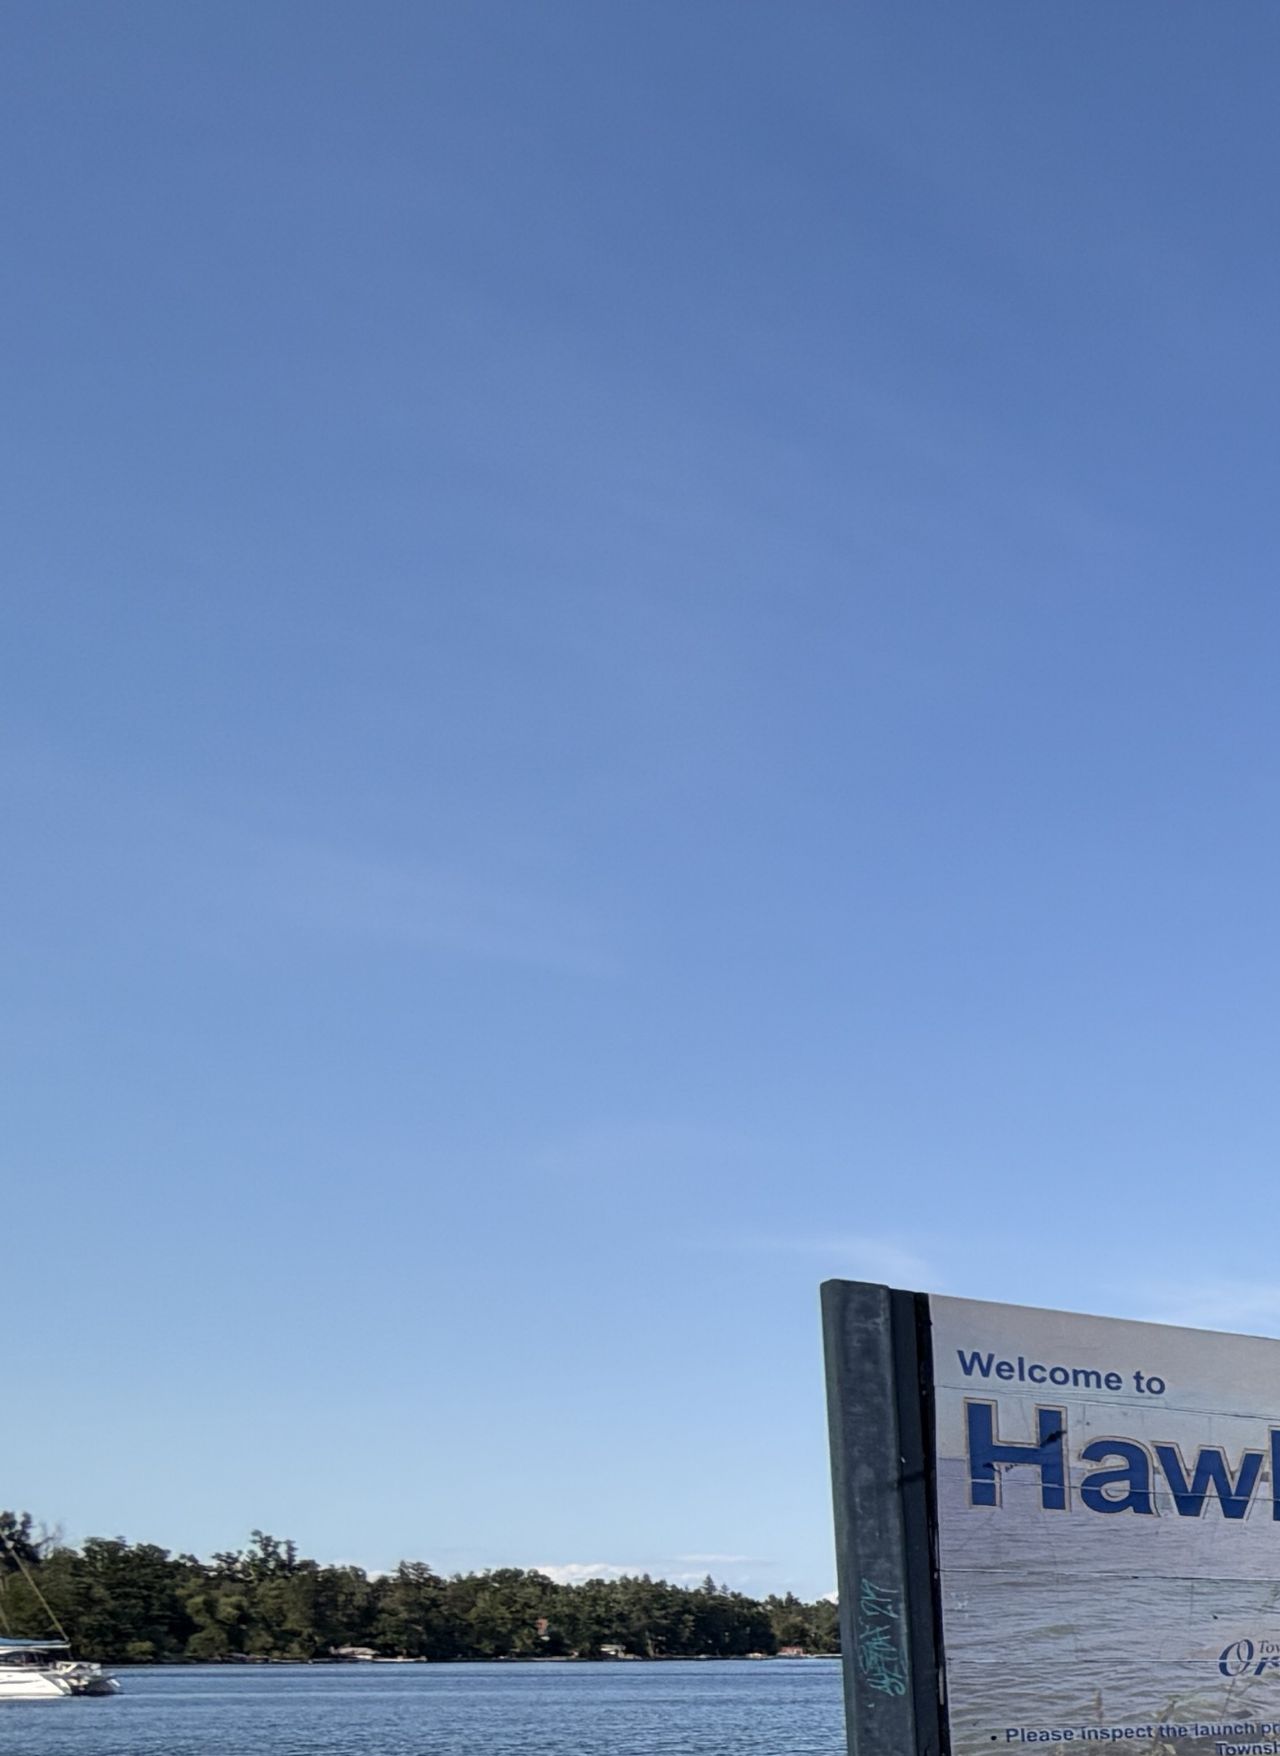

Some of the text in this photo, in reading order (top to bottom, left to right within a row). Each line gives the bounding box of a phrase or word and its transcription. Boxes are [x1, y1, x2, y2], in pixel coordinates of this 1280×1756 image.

[957, 1349, 1166, 1396] Welcome to
[1005, 1727, 1074, 1743] Please
[1081, 1724, 1153, 1744] inspect
[1159, 1723, 1188, 1739] the
[1194, 1721, 1255, 1737] launch
